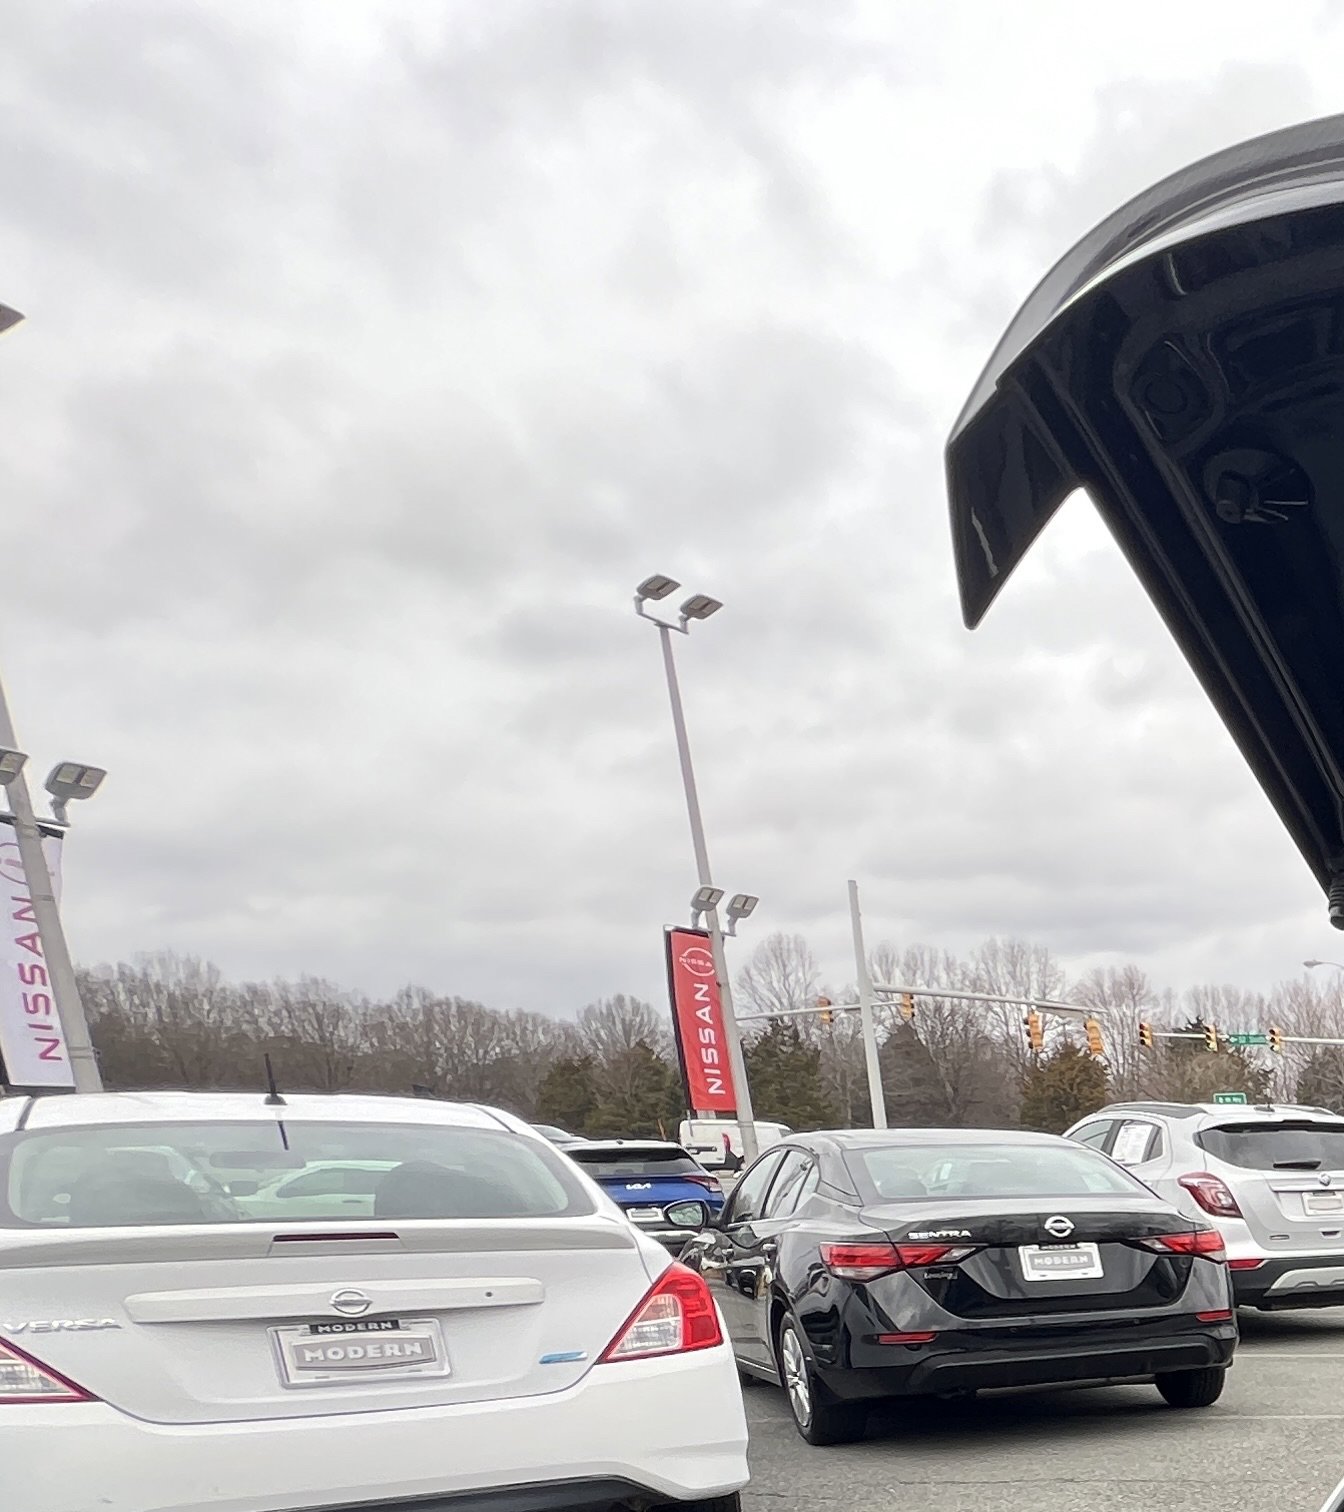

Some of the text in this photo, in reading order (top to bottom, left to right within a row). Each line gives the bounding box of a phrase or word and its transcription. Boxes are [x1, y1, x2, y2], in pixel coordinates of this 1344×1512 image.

[11, 895, 63, 1061] NISSAN
[693, 982, 726, 1095] NISSAN
[907, 1230, 972, 1240] SENTRA
[1033, 1255, 1089, 1266] MODERN
[2, 1318, 122, 1334] VERSA
[317, 1321, 393, 1333] MODERN
[303, 1343, 423, 1363] MODERN
